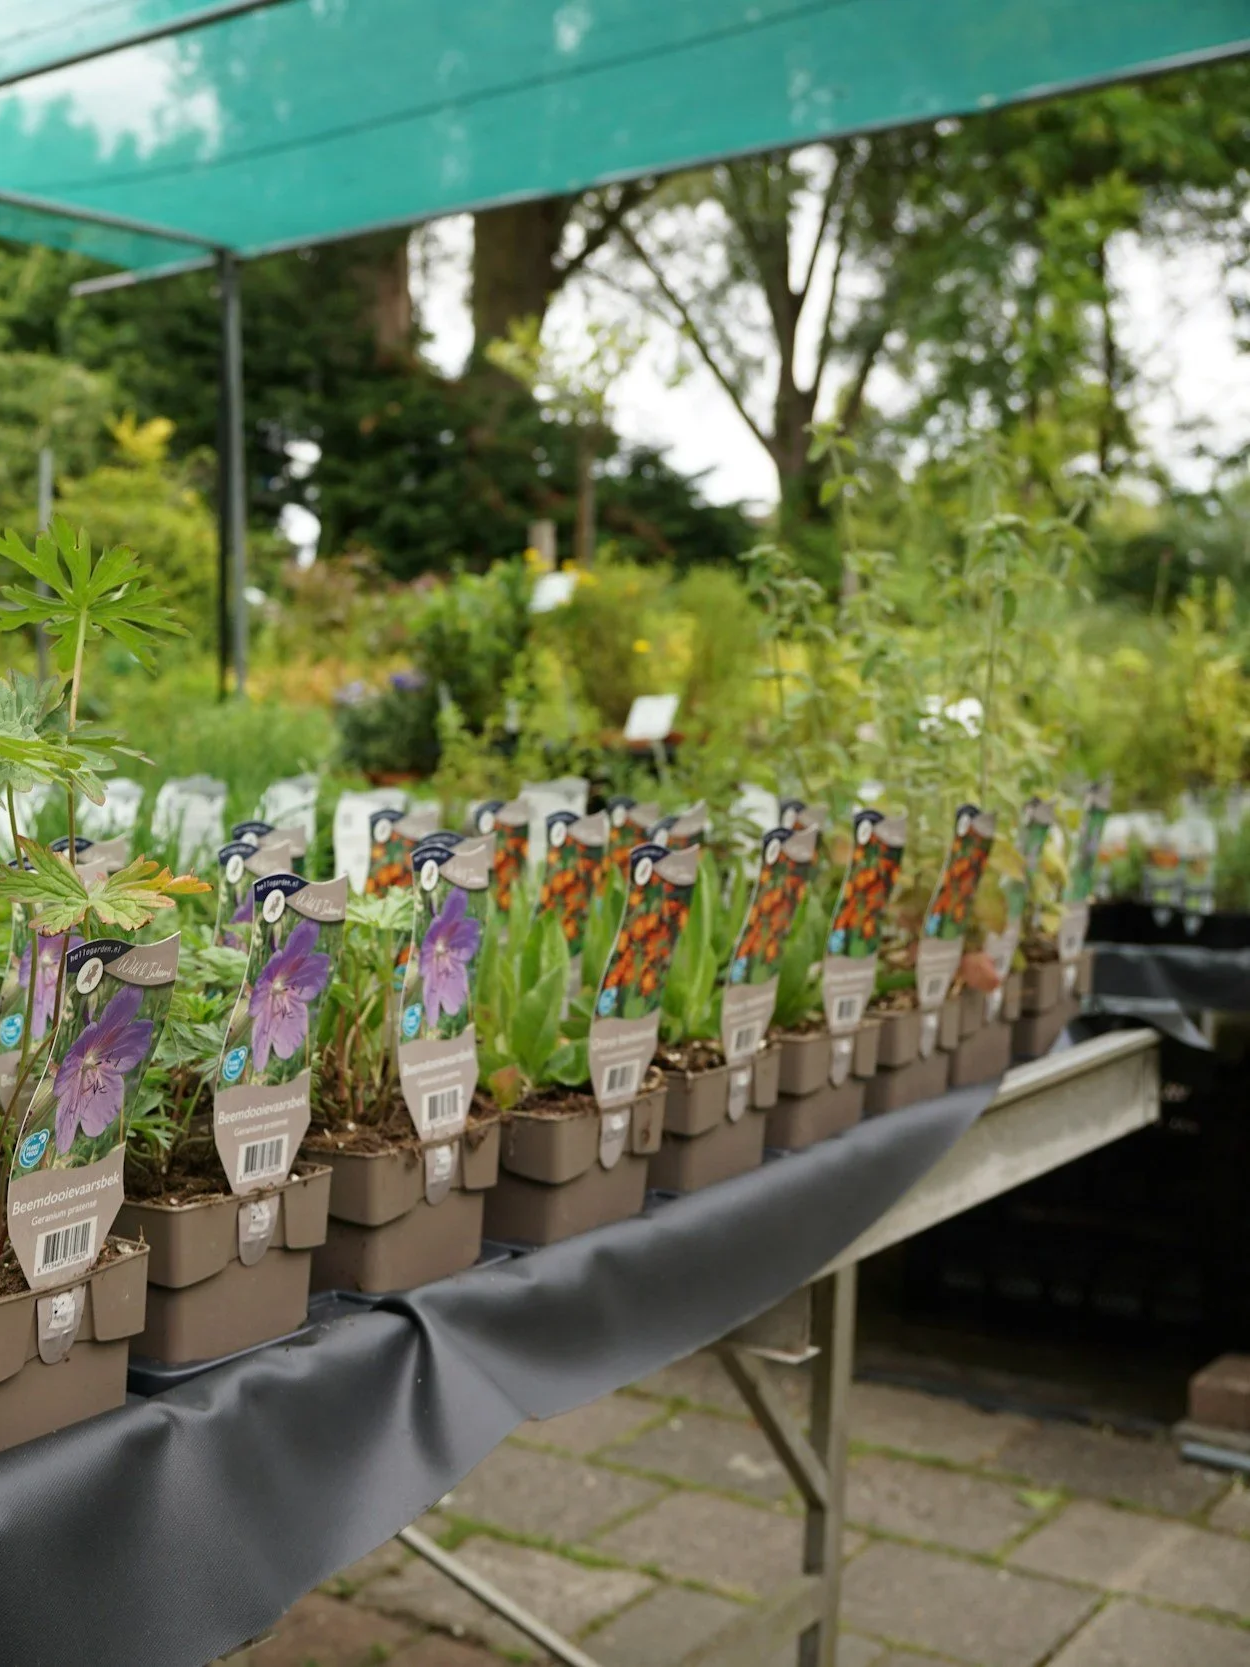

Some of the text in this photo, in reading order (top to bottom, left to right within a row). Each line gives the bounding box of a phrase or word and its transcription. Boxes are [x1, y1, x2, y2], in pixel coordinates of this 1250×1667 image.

[70, 945, 122, 962] hellogarden.nl
[217, 1093, 307, 1125] Beemdooievaarsbek
[12, 1172, 120, 1217] Beemdooievaarsbek
[31, 1200, 98, 1227] Geranium pratense
